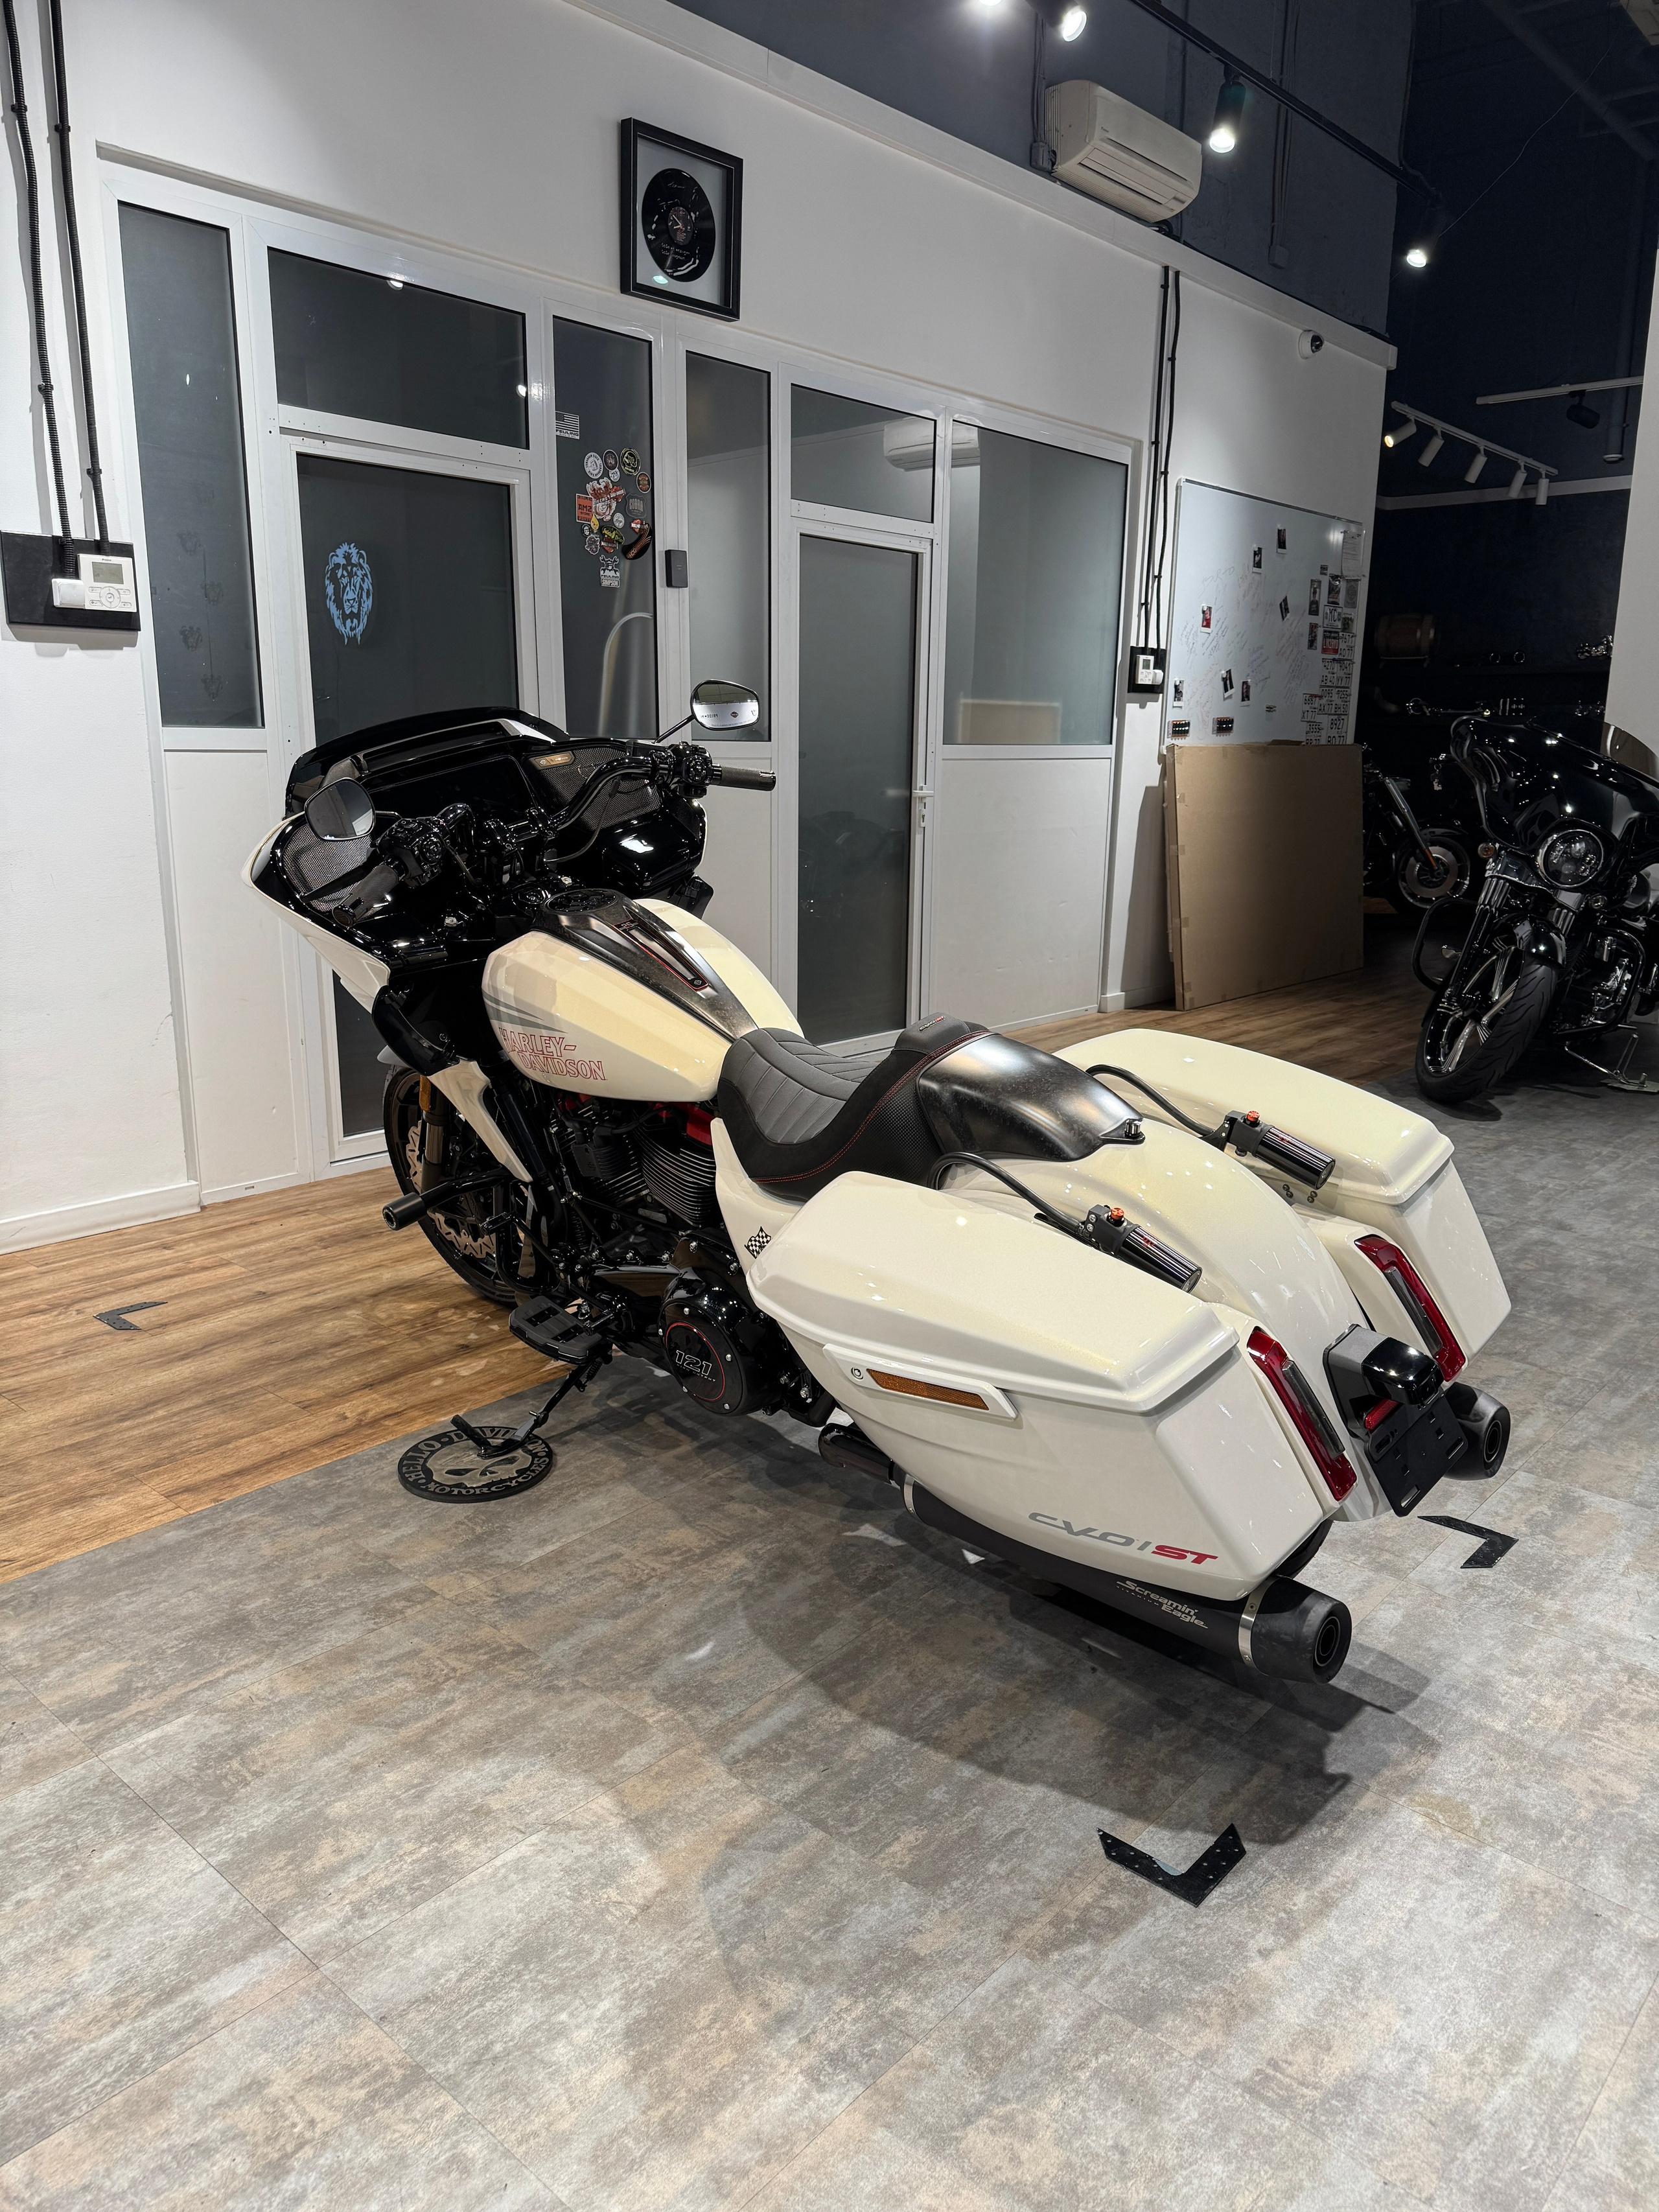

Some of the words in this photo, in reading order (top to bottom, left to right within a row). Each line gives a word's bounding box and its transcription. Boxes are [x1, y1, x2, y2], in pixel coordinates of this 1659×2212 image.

[629, 498, 643, 511] COBRA
[1347, 649, 1352, 658] 77
[1345, 677, 1351, 686] 77
[1310, 710, 1316, 720] 77
[1327, 704, 1333, 713] 77
[1330, 718, 1345, 730] 8927
[499, 1027, 577, 1058] HARLEY-
[516, 1051, 608, 1081] DAVIDSON
[675, 1349, 712, 1376] 121
[402, 1439, 442, 1483] HELLO
[420, 1456, 550, 1495] MOTORCYCLES
[1028, 1512, 1135, 1547] CVO
[1151, 1544, 1218, 1565] ST
[1116, 1580, 1198, 1616] Screamin'
[1161, 1604, 1209, 1629] Eagle
